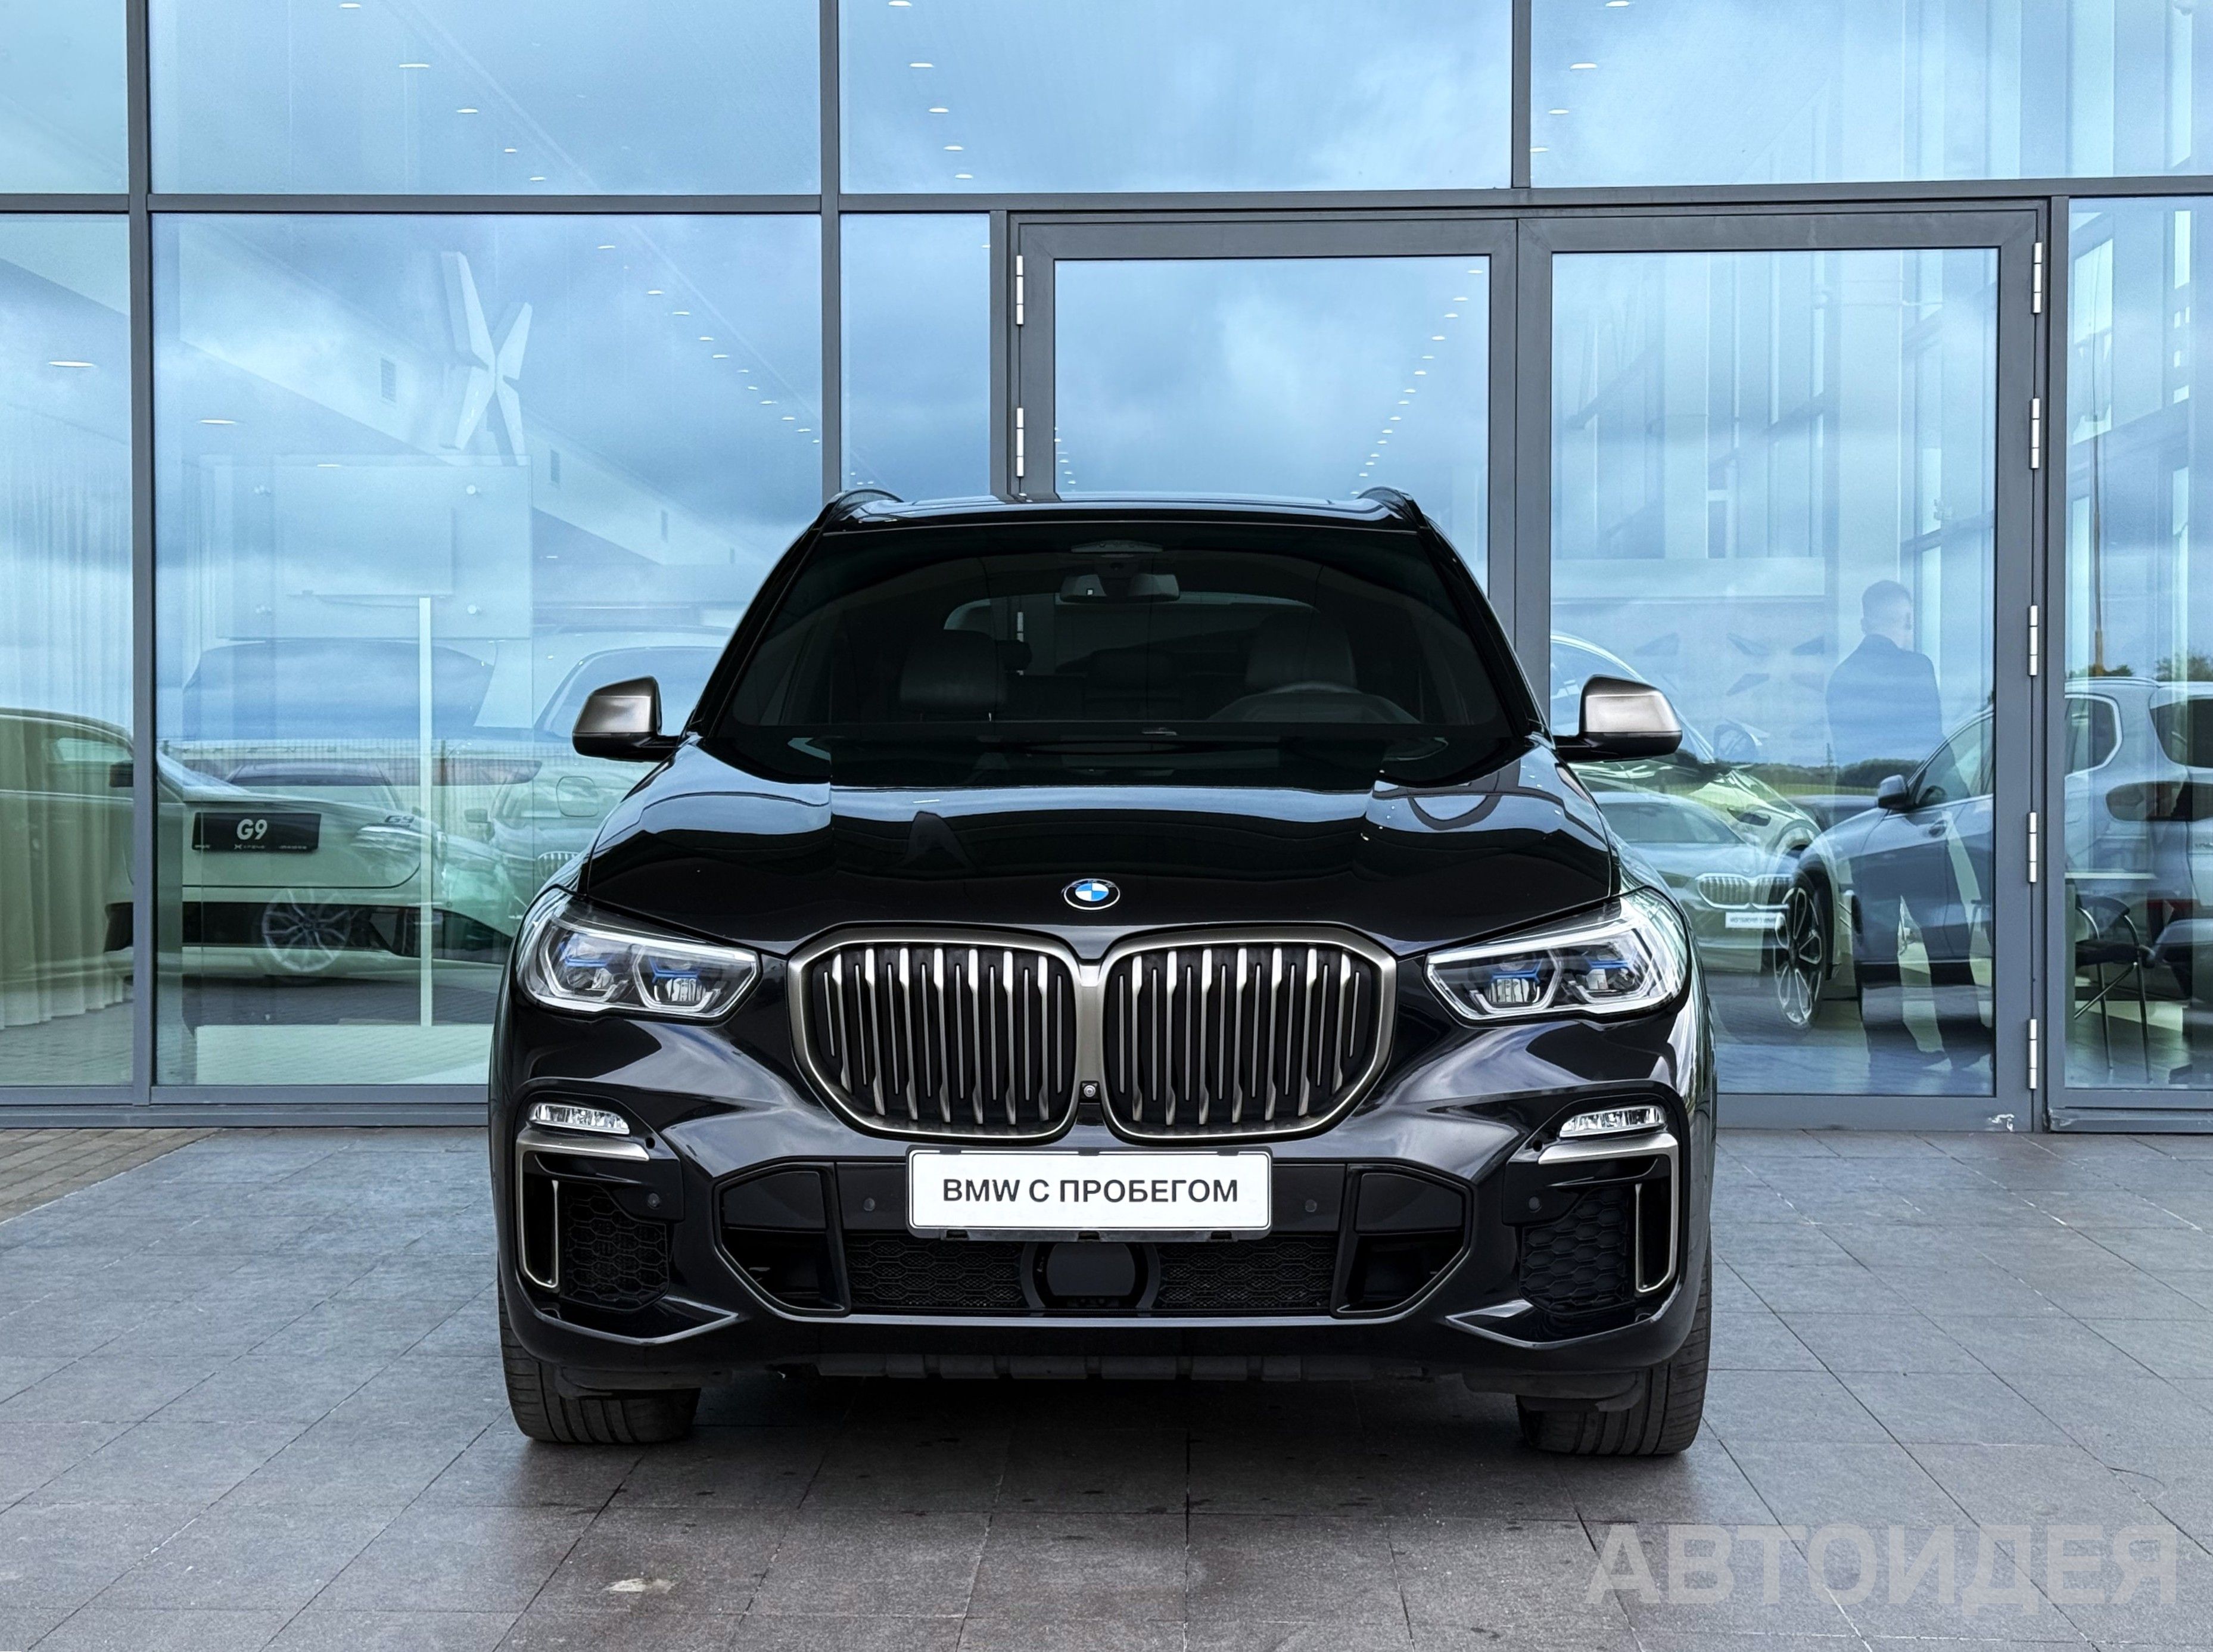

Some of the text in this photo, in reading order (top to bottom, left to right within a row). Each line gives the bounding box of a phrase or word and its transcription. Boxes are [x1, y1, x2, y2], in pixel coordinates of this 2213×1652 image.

[236, 819, 268, 840] G9
[943, 1179, 1238, 1203] BMW С ПРОБЕГОМ
